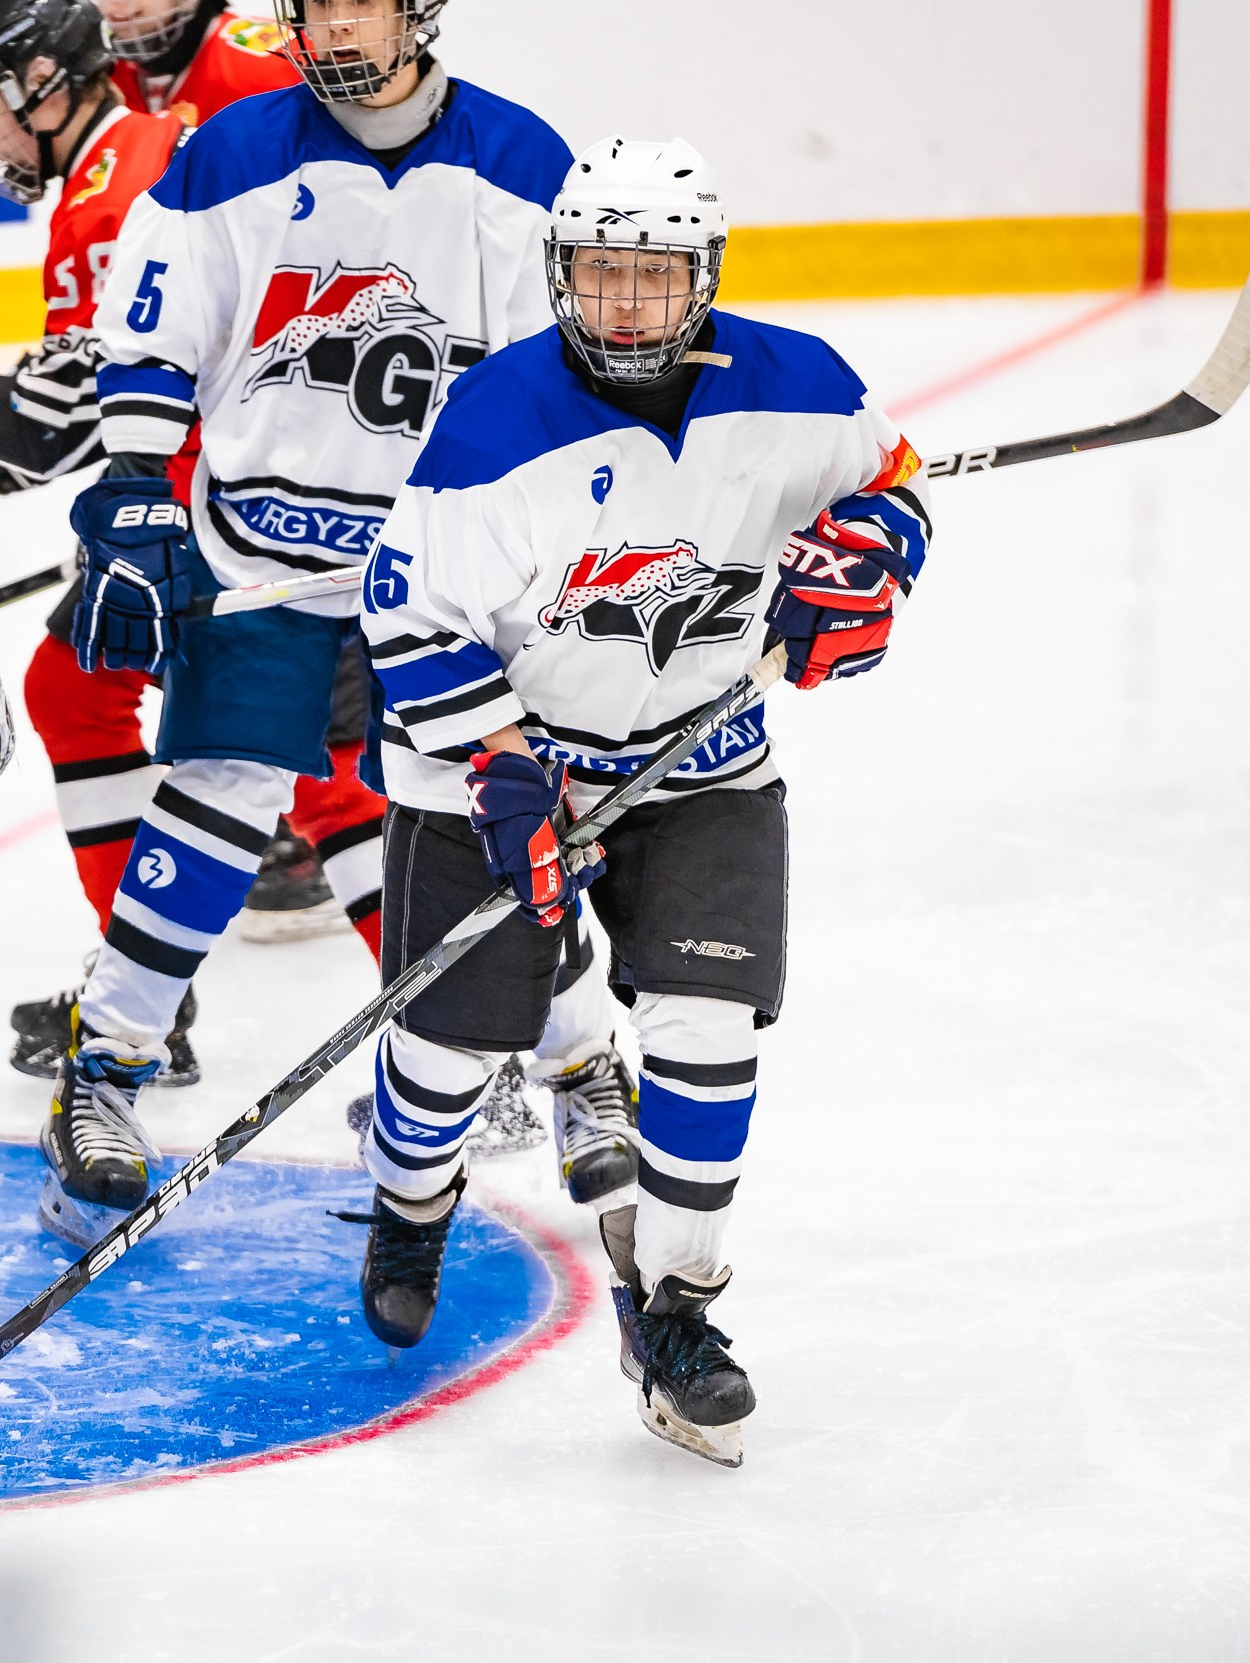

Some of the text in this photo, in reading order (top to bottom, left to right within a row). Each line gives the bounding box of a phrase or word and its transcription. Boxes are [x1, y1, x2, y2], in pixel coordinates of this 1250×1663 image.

[126, 259, 169, 334] 5
[778, 534, 866, 587] STX
[829, 618, 864, 631] STALLION
